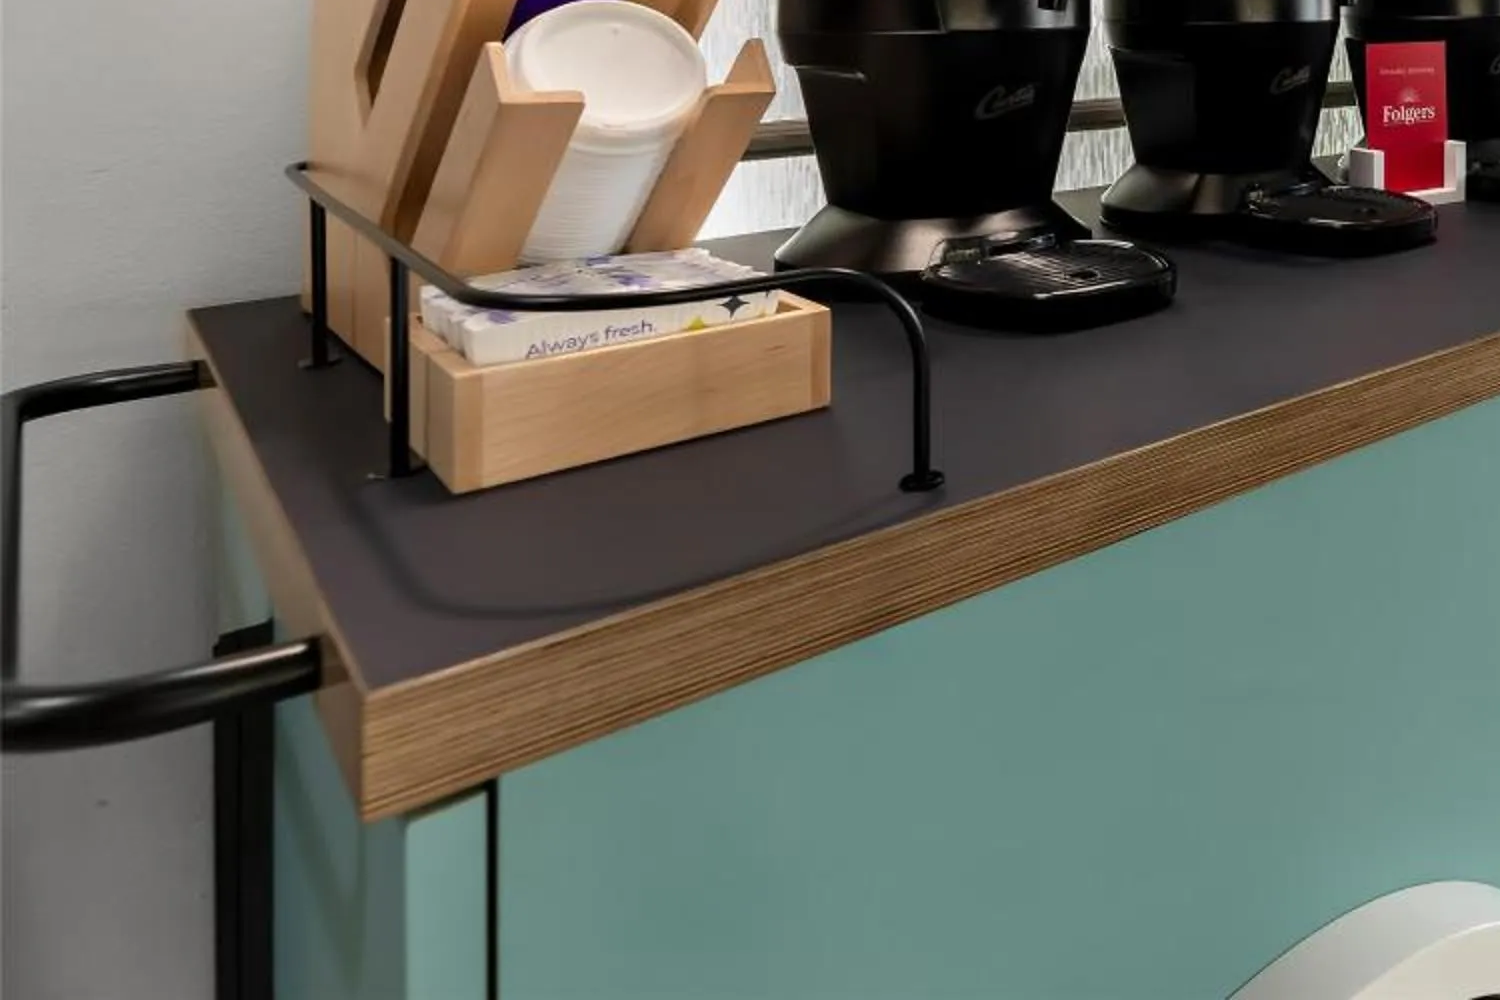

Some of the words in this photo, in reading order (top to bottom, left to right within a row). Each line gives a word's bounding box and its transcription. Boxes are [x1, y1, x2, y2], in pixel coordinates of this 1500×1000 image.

[1382, 105, 1437, 126] Folgers
[524, 330, 600, 360] Always
[604, 319, 658, 341] fresh.
